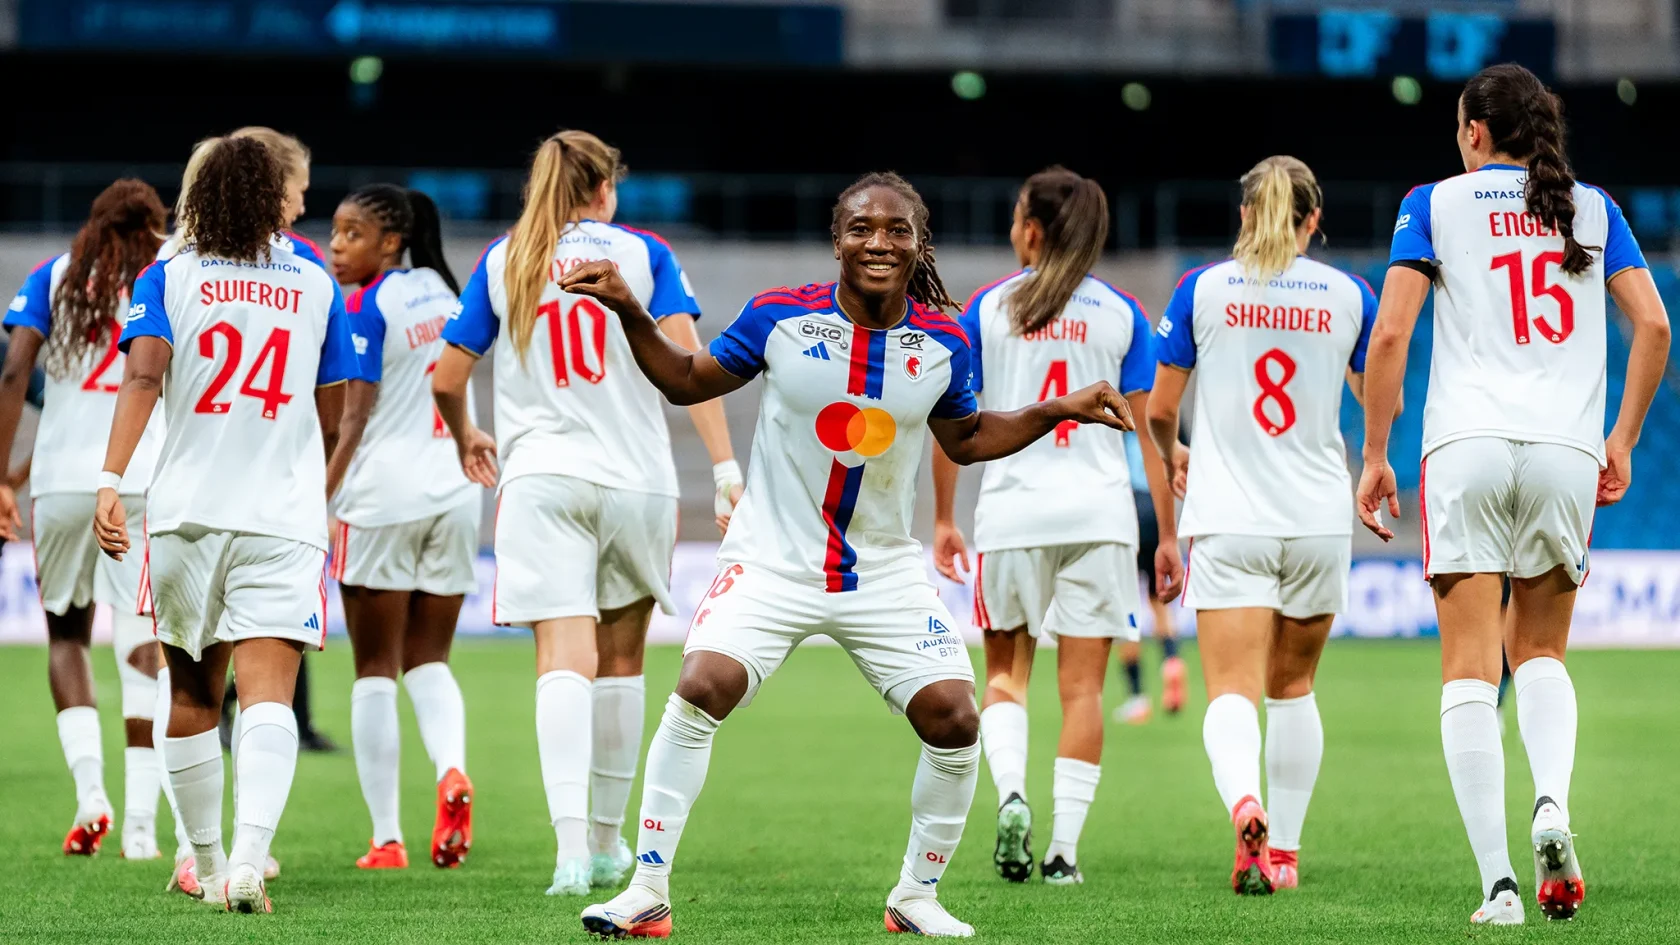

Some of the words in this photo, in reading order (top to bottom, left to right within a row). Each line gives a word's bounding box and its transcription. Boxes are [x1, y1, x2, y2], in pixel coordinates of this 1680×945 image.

[1474, 190, 1524, 199] DATASO
[1489, 211, 1556, 237] ENGE
[200, 279, 303, 314] SWIEROT
[1228, 276, 1328, 292] DAOLUTION
[1490, 249, 1575, 345] 15
[801, 321, 842, 341] ÖKO
[1225, 303, 1332, 334] SHRADER
[535, 297, 607, 388] 10
[194, 320, 294, 421] 24
[1037, 359, 1080, 448] 4
[1252, 347, 1297, 438] 8
[708, 563, 744, 599] 6
[643, 818, 665, 832] OL
[926, 851, 946, 864] OL
